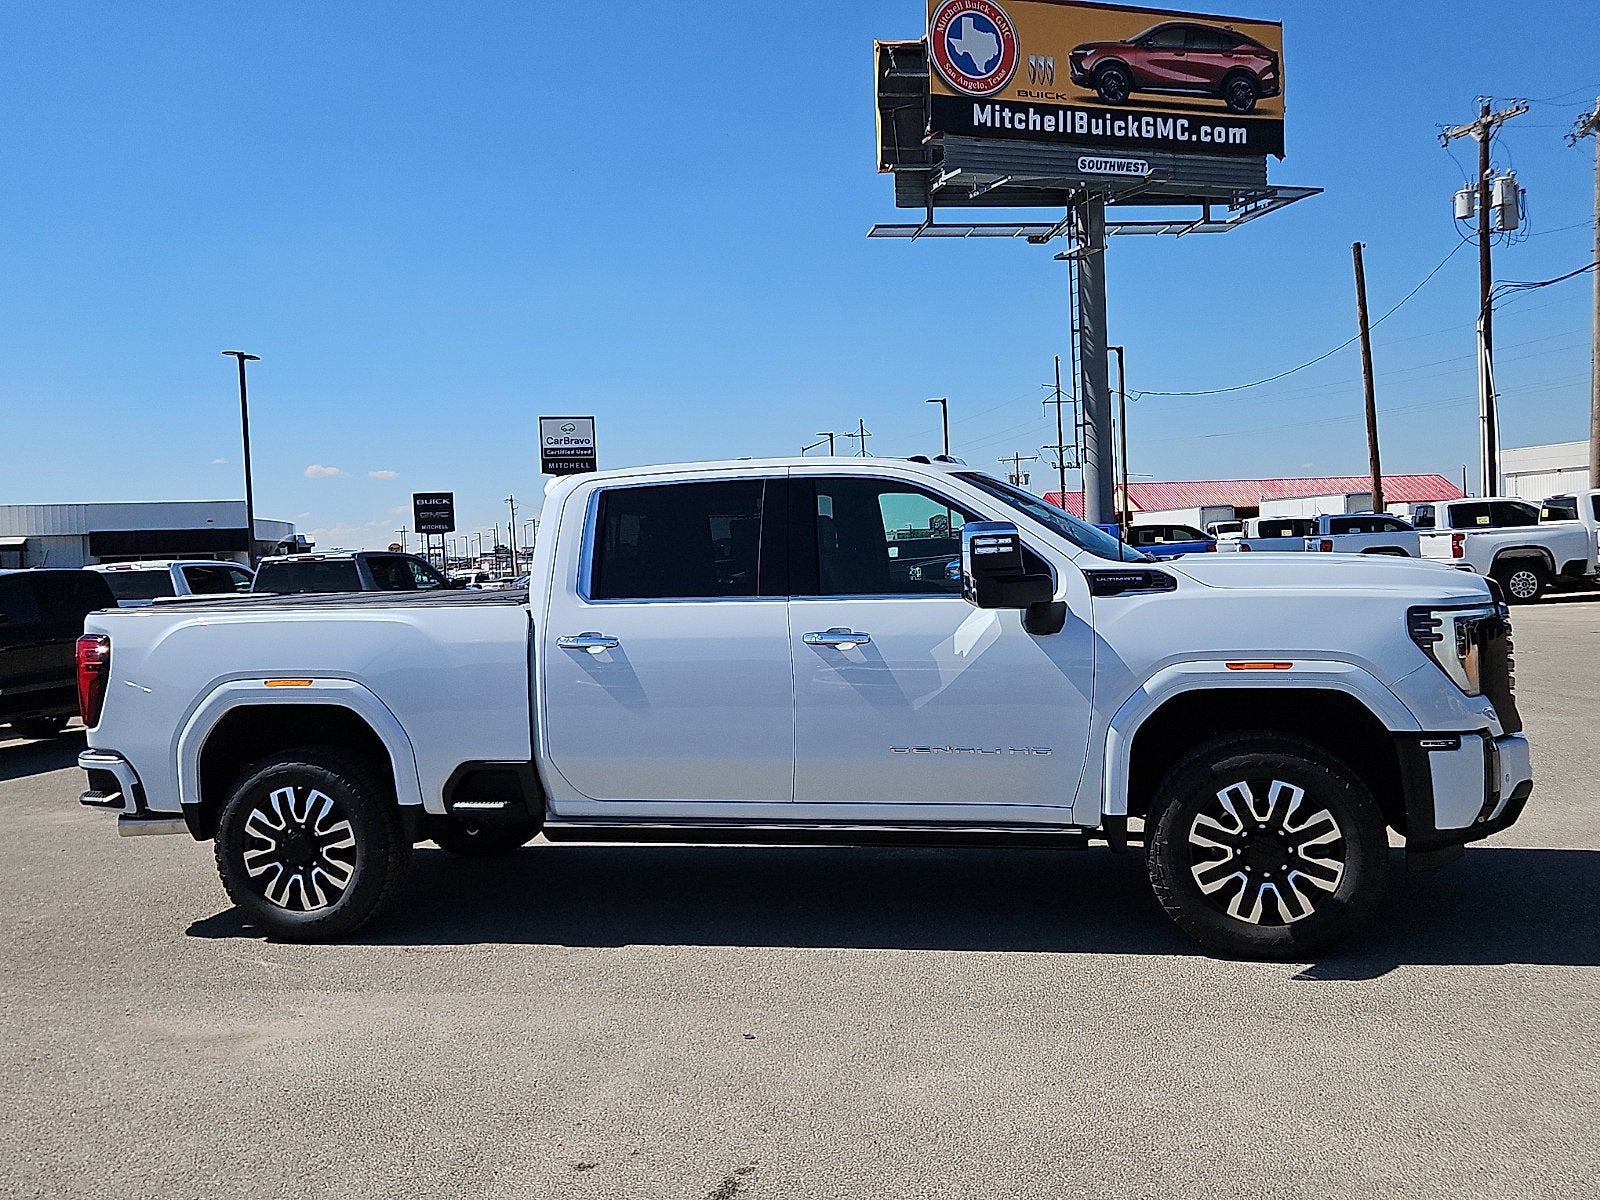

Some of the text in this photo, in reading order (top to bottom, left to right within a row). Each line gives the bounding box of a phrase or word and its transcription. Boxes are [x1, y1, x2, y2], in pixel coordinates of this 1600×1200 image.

[936, 1, 964, 34] Mitchell
[965, 0, 990, 14] Buick
[995, 15, 1012, 40] GMC
[943, 62, 1007, 90] San Angelo, Texas
[1017, 90, 1067, 100] BUICK
[974, 104, 1247, 144] MitchellBuickGMC.com
[1079, 158, 1147, 174] SOUTHWEST
[546, 436, 590, 445] CarBravo
[890, 745, 1053, 755] DENALI HD
